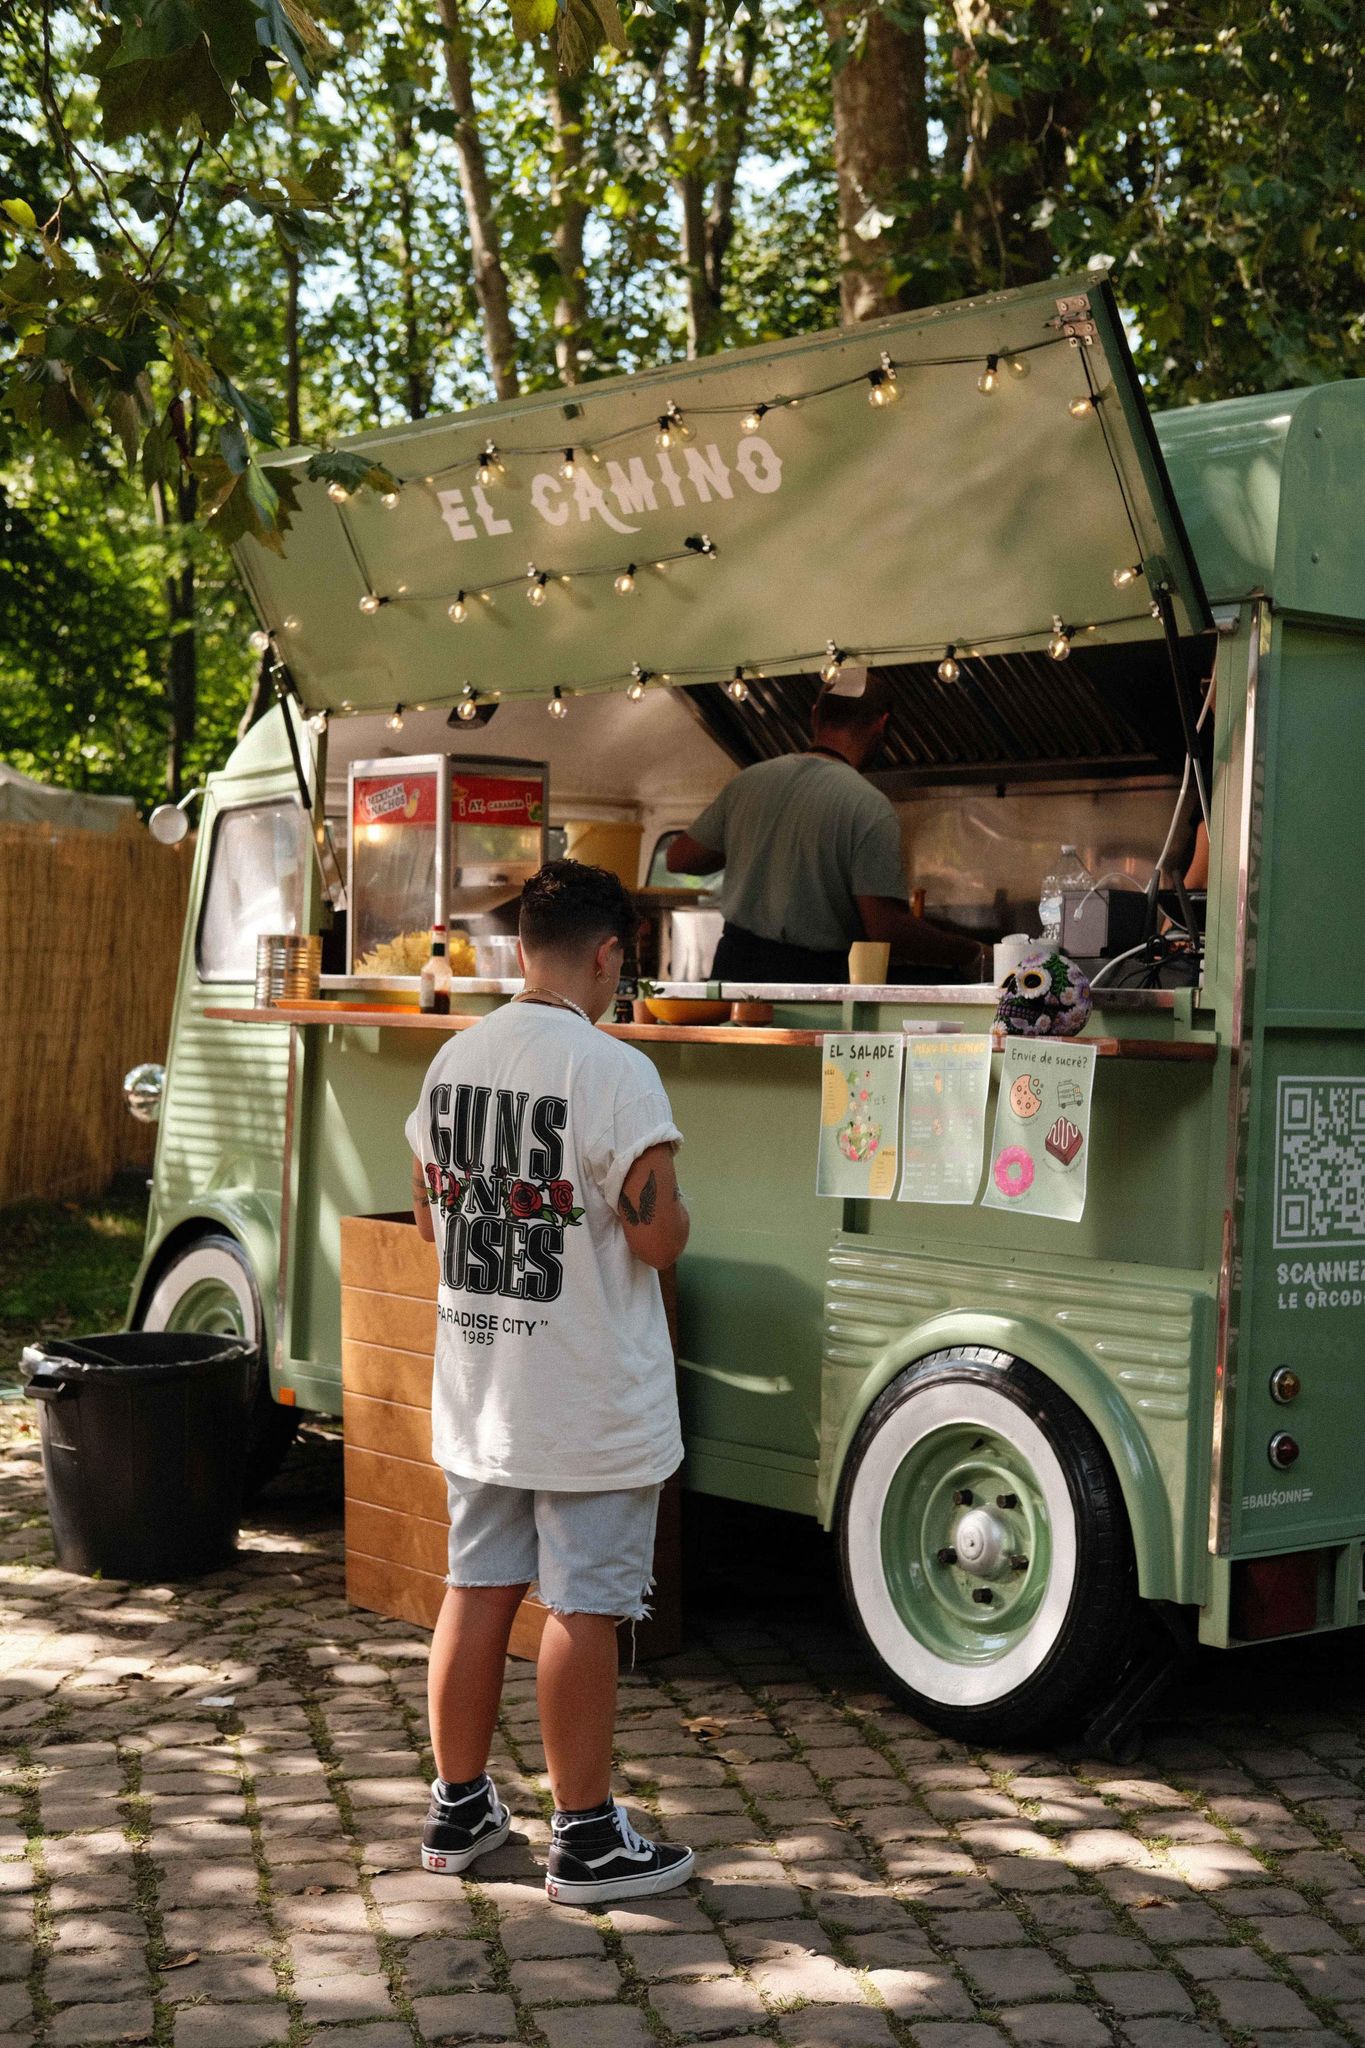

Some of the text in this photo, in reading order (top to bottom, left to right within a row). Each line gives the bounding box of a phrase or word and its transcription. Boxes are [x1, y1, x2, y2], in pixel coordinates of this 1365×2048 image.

[437, 436, 783, 541] EL CAMINO
[371, 795, 406, 815] NACHOS
[830, 1044, 844, 1058] EL
[850, 1044, 895, 1060] SALADE
[1011, 1048, 1088, 1069] Envie de sucré?
[430, 1083, 568, 1182] GUNS
[441, 1210, 563, 1302] OSES
[1278, 1292, 1298, 1309] LE
[462, 1330, 495, 1346] 1985
